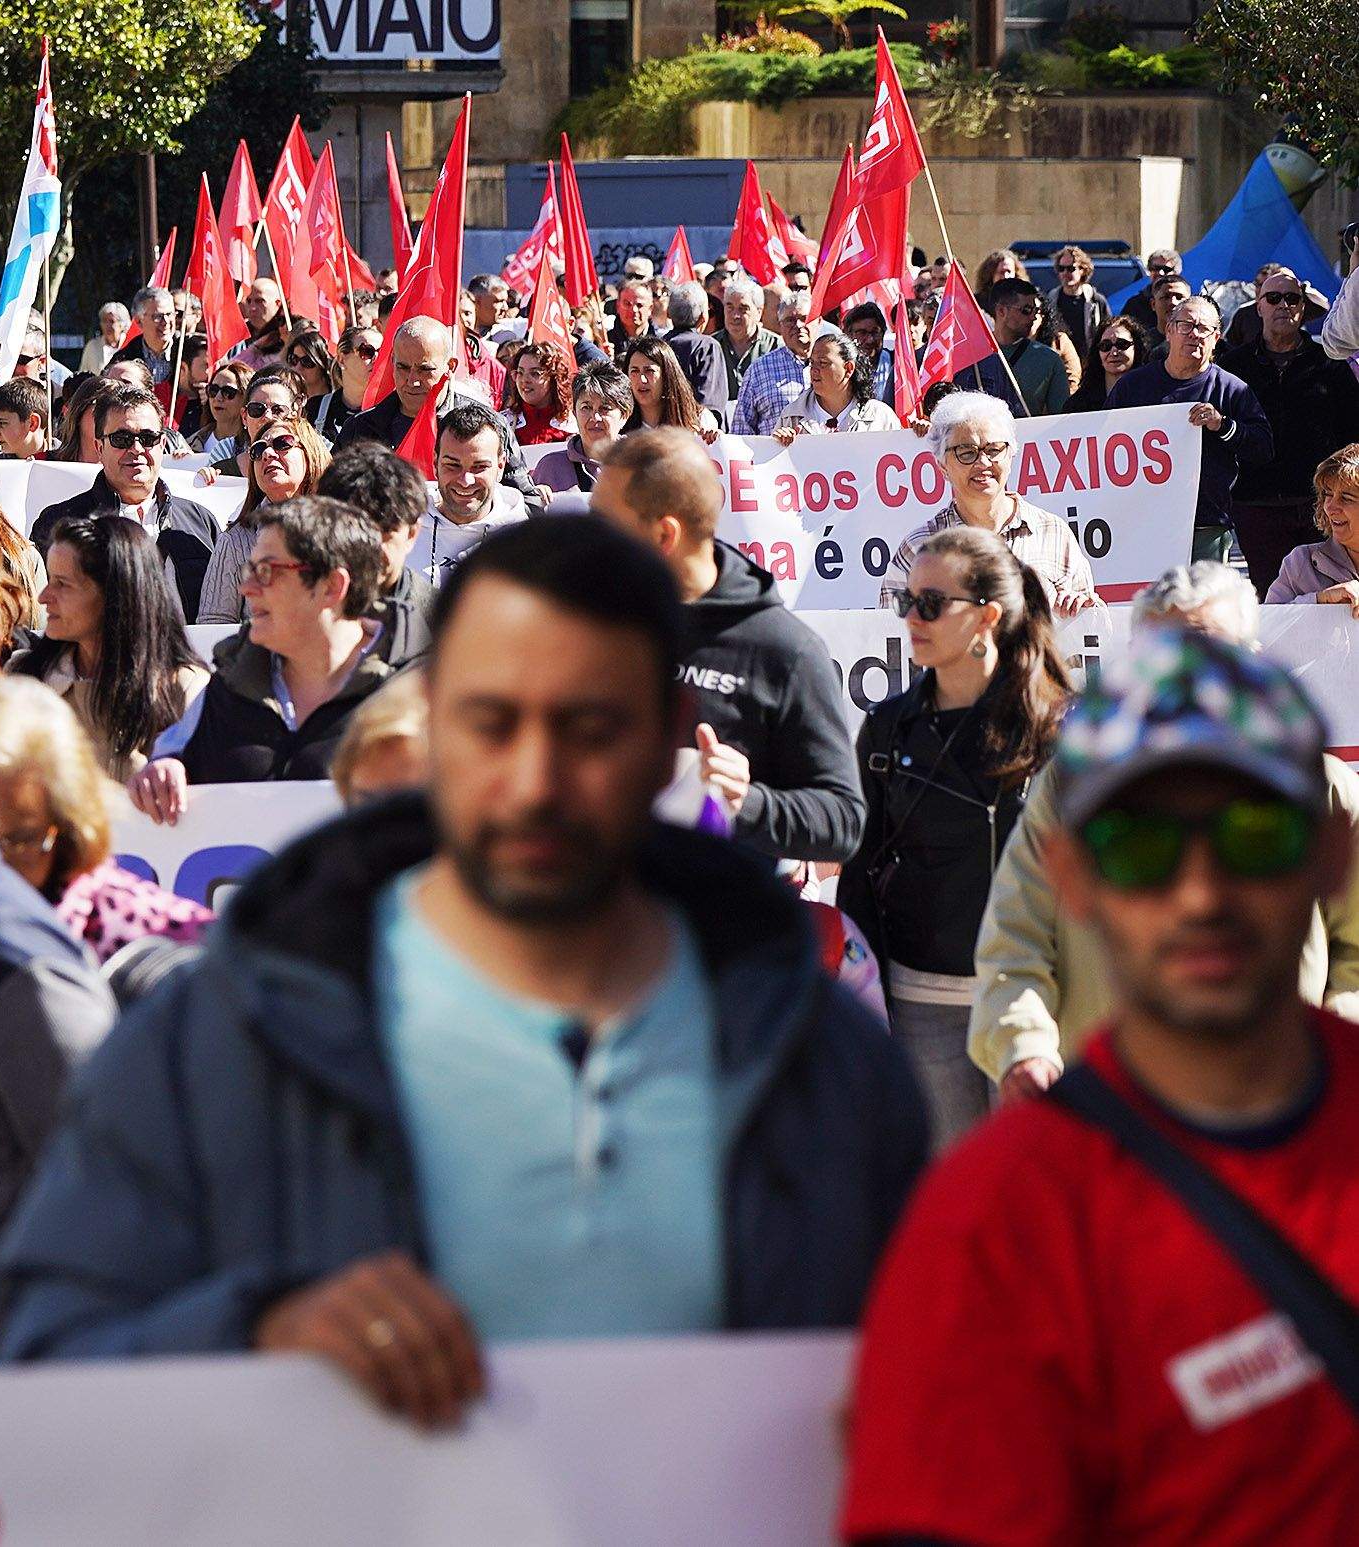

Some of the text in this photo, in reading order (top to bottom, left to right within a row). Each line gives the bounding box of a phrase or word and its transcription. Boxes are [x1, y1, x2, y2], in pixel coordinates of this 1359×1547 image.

[775, 471, 860, 513] aos
[876, 430, 1173, 508] COAXIOS
[814, 524, 844, 580] é
[862, 537, 891, 577] o
